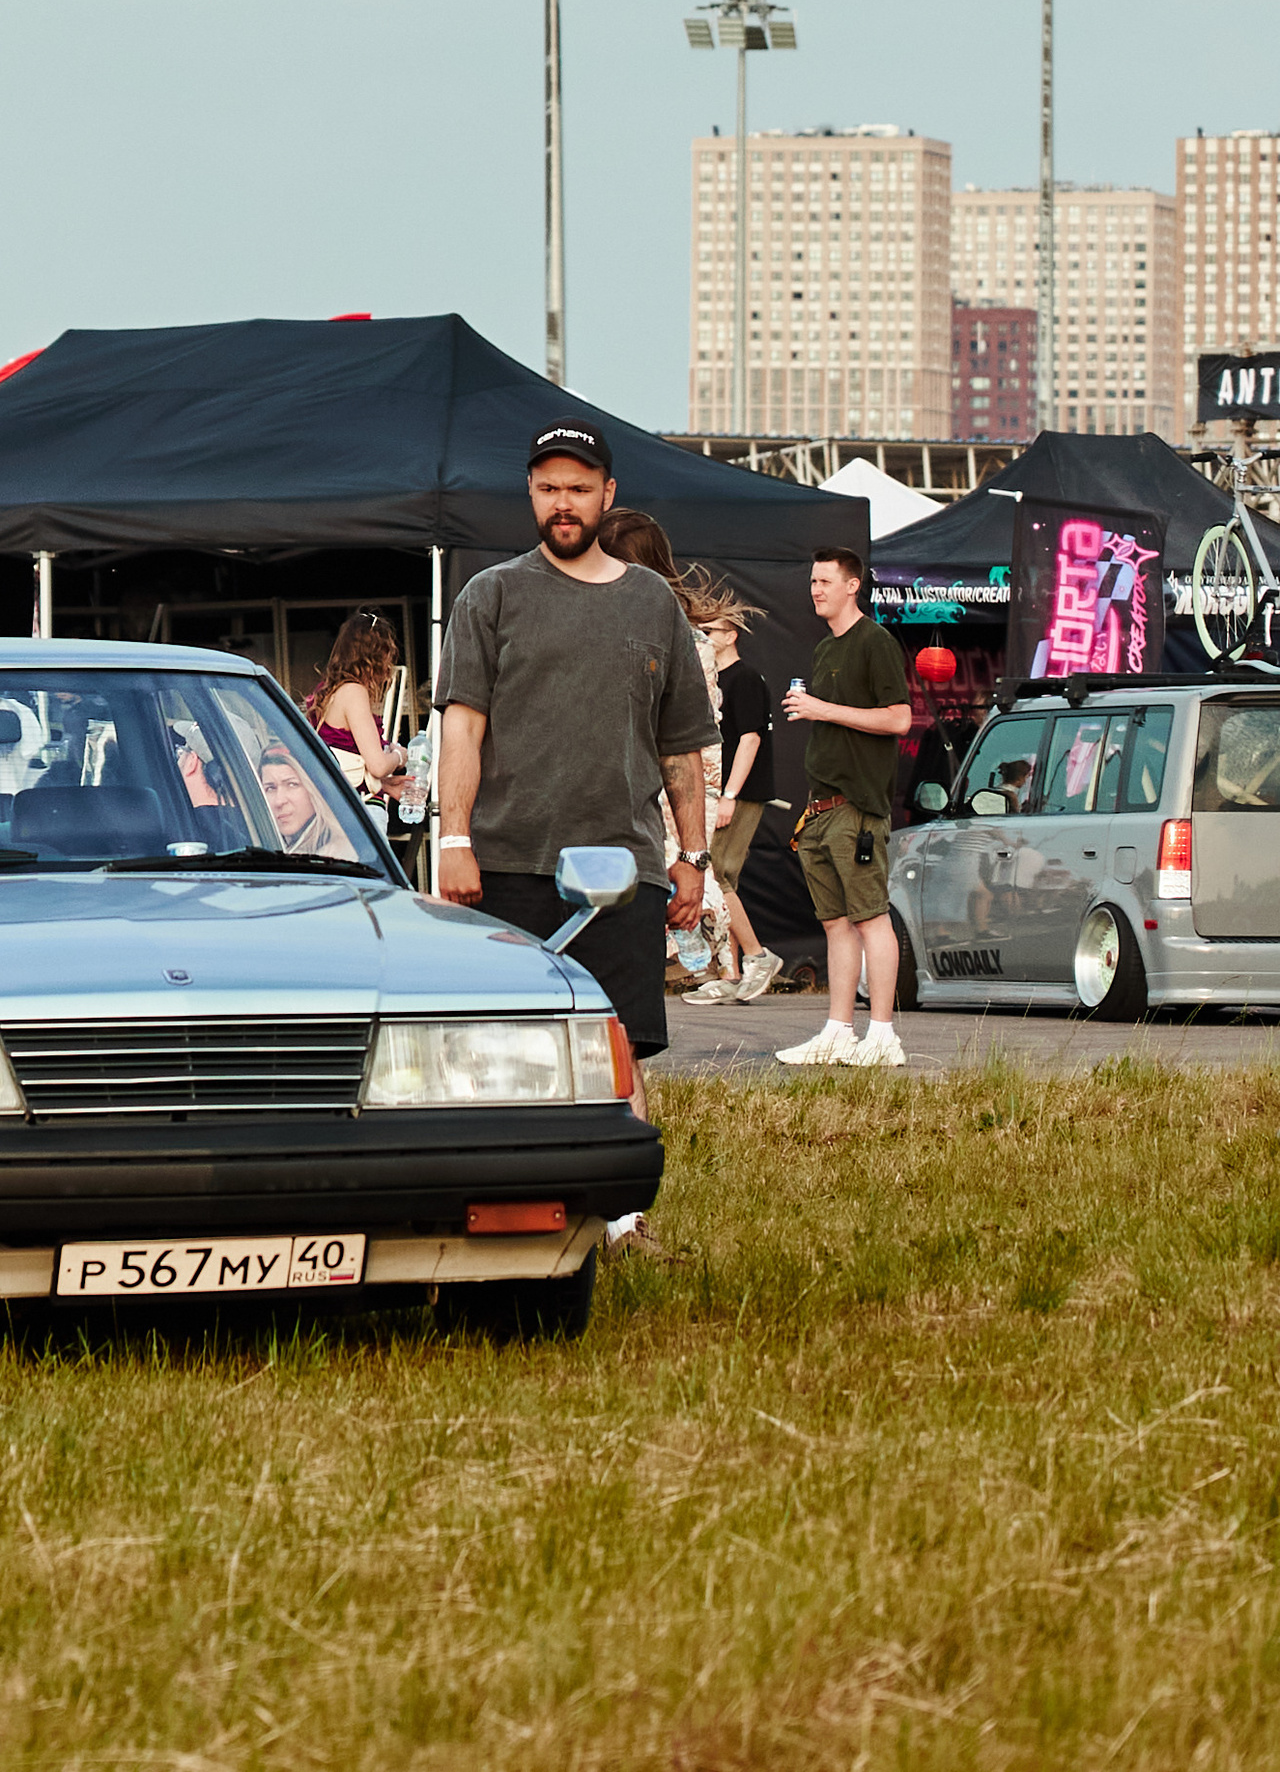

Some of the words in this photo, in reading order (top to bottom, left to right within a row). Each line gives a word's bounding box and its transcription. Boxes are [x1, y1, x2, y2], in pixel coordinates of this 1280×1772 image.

[932, 949, 1004, 977] LOWDAILY
[297, 1240, 345, 1270] 40
[291, 1270, 327, 1283] RUS
